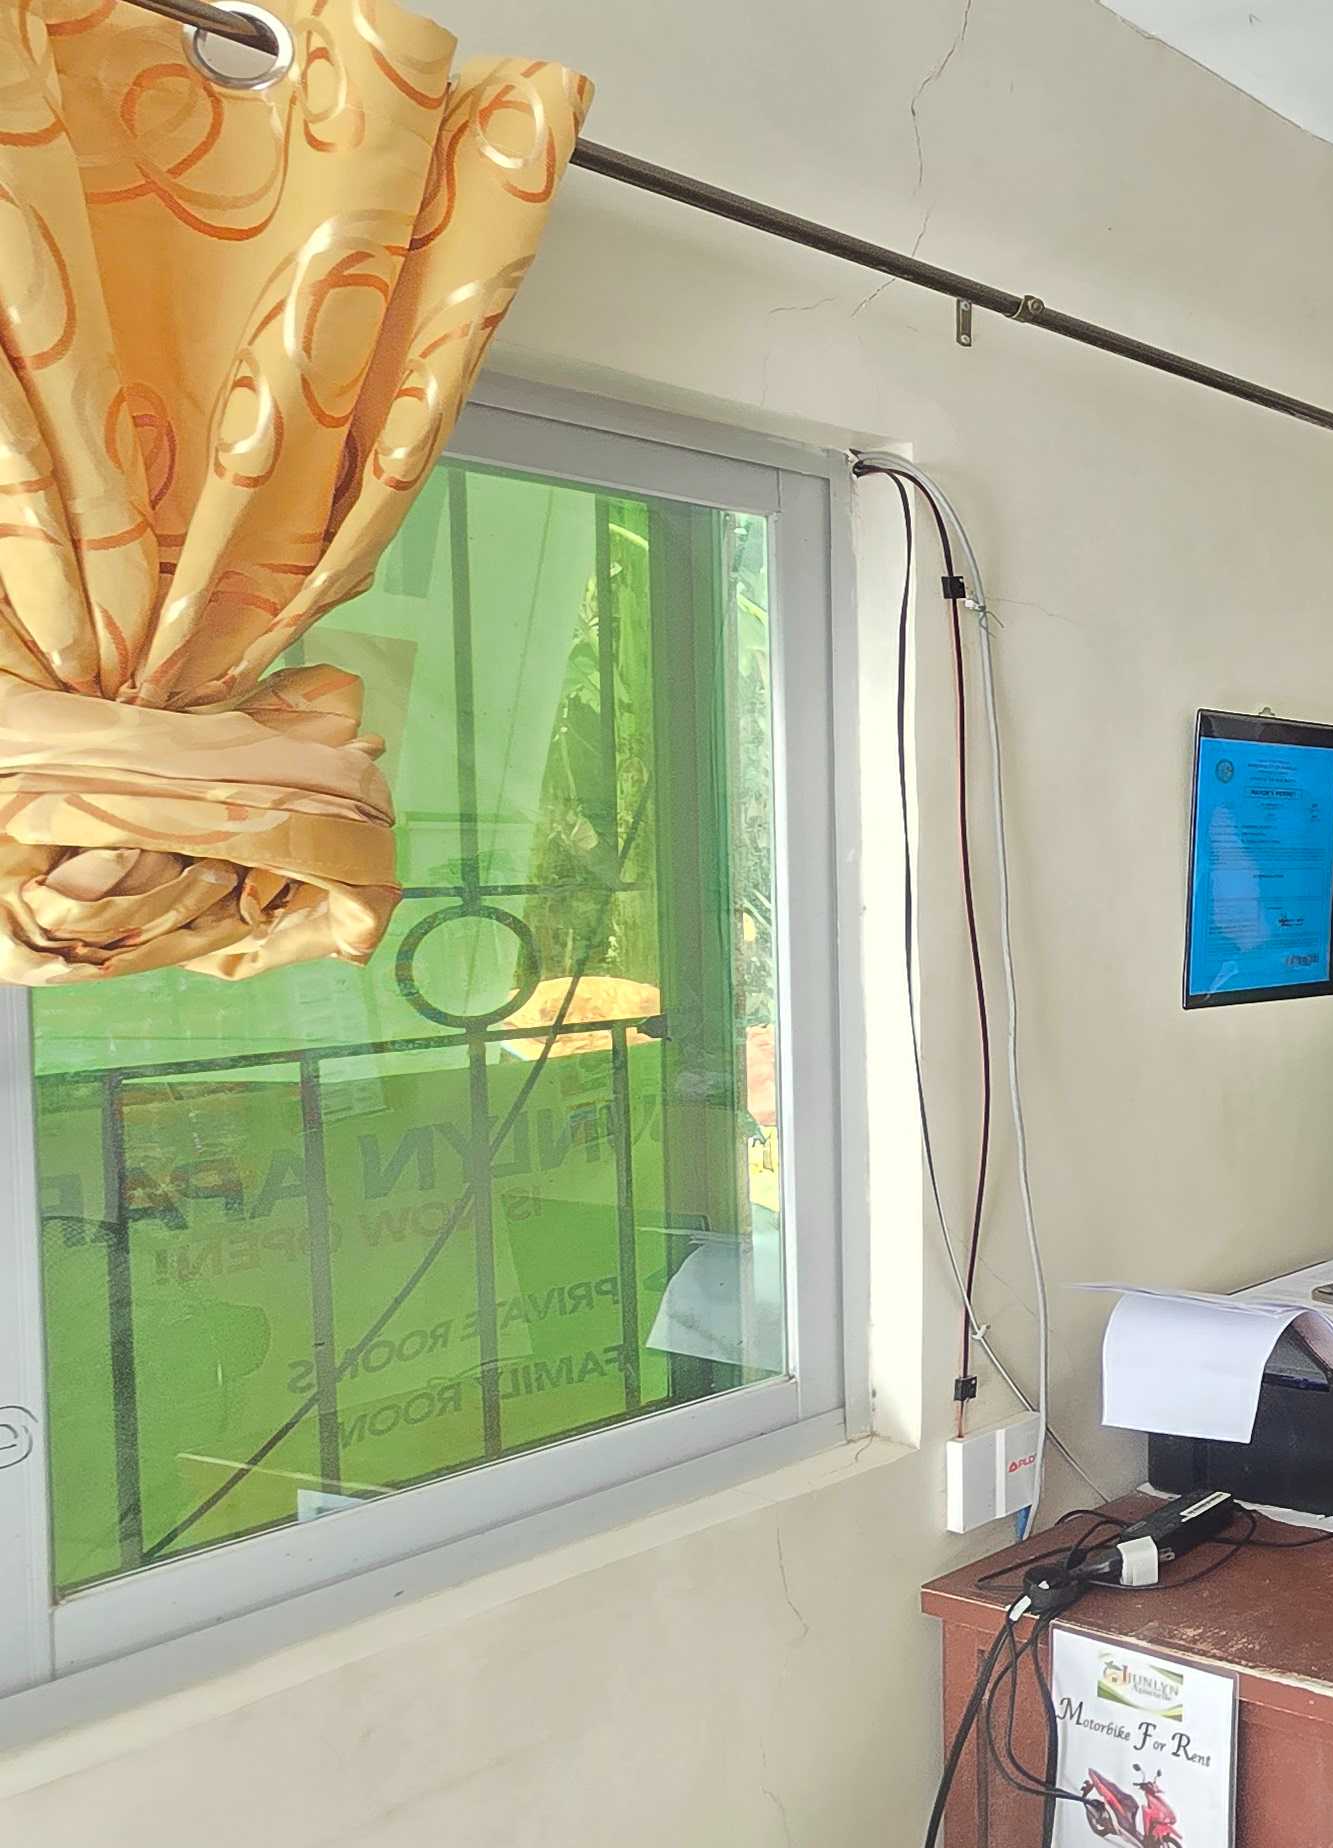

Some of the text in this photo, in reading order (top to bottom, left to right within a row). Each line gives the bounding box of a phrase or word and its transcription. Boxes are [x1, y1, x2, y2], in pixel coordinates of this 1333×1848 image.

[1057, 1696, 1212, 1768] Motorbike For Rent
